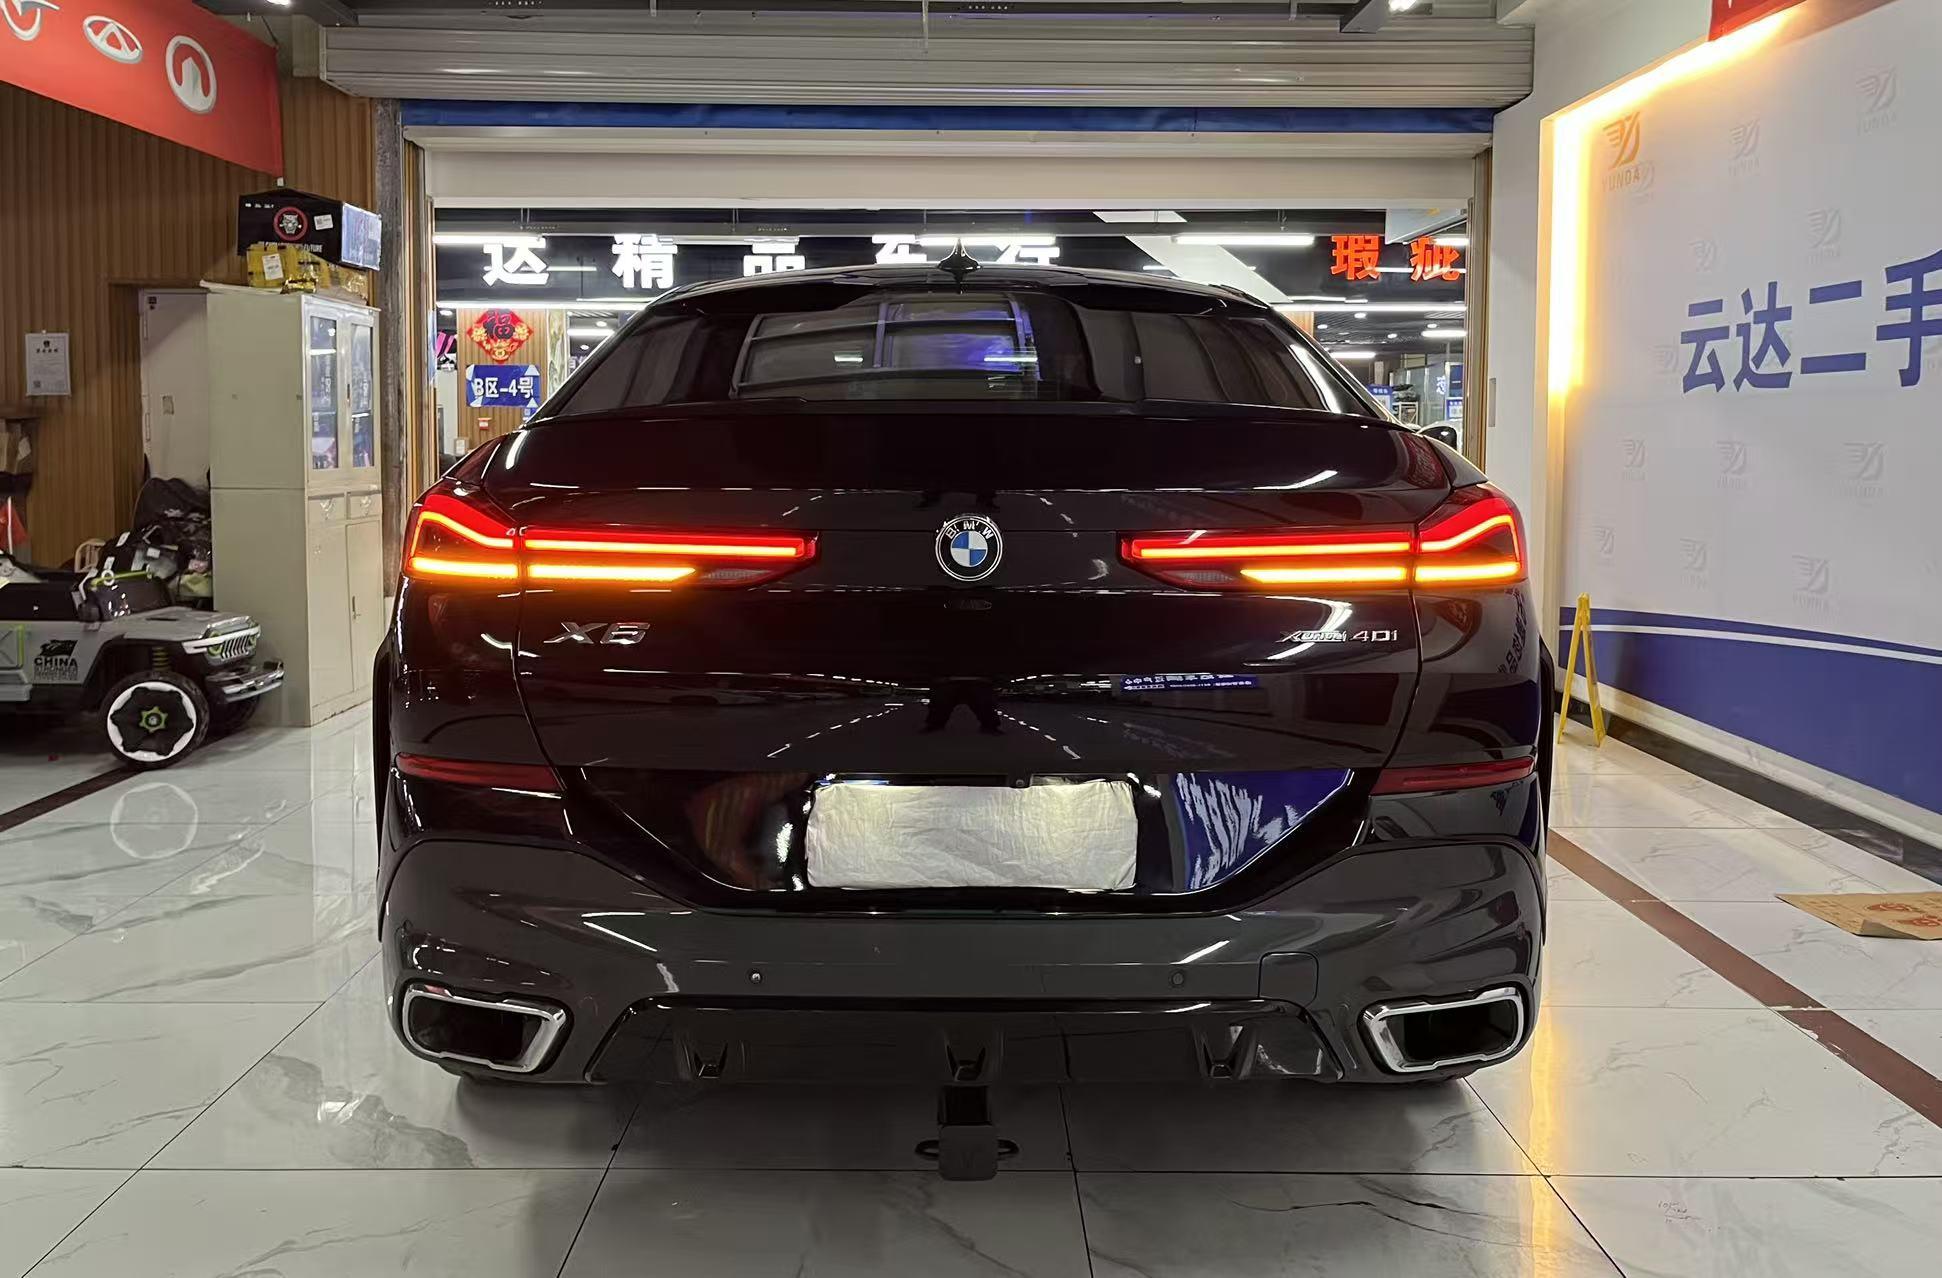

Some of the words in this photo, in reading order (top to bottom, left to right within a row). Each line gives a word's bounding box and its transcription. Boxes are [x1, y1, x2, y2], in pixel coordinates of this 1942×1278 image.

[1601, 167, 1641, 192] YUNDA
[1681, 249, 1942, 394] 云达二手
[473, 377, 534, 399] B区-4号
[945, 520, 994, 540] BMW
[543, 621, 651, 645] X6
[34, 657, 78, 667] CHINA
